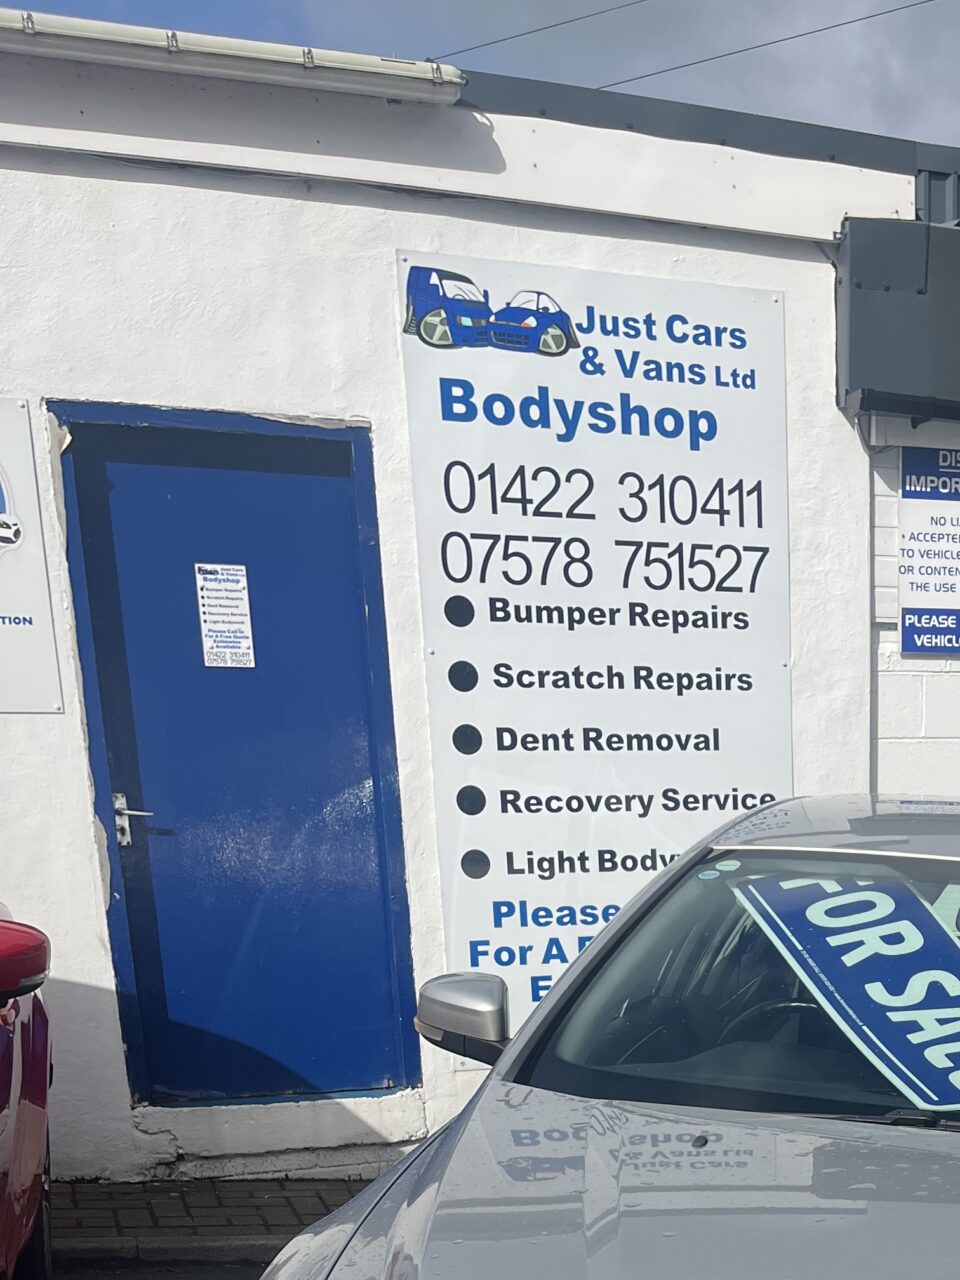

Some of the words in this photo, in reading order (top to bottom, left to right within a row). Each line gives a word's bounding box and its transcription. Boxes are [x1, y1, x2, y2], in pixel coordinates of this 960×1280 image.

[575, 305, 656, 341] Just
[666, 315, 747, 349] Cars
[579, 346, 606, 376] &
[614, 349, 705, 384] Vans
[715, 366, 756, 389] Ltd
[439, 378, 718, 450] Bodyshop
[444, 460, 596, 520] 01422
[618, 472, 763, 528] 310411
[930, 516, 946, 526] NO
[441, 531, 593, 587] 07578
[614, 540, 769, 593] 751527
[900, 549, 914, 558] TO
[899, 565, 914, 575] OR
[909, 582, 930, 592] THE
[934, 583, 956, 592] USE
[488, 597, 620, 631] Bumper
[628, 602, 749, 633] Repairs
[905, 615, 956, 628] PLEASE
[493, 663, 625, 689] Scratch
[633, 666, 753, 695] Repairs
[496, 727, 574, 751] Dent
[582, 727, 719, 751] Removal
[500, 789, 654, 817] Recovery
[662, 788, 776, 811] Service
[505, 850, 590, 880] Light
[493, 900, 621, 928] Please
[469, 940, 532, 967] For
[542, 937, 568, 963] A
